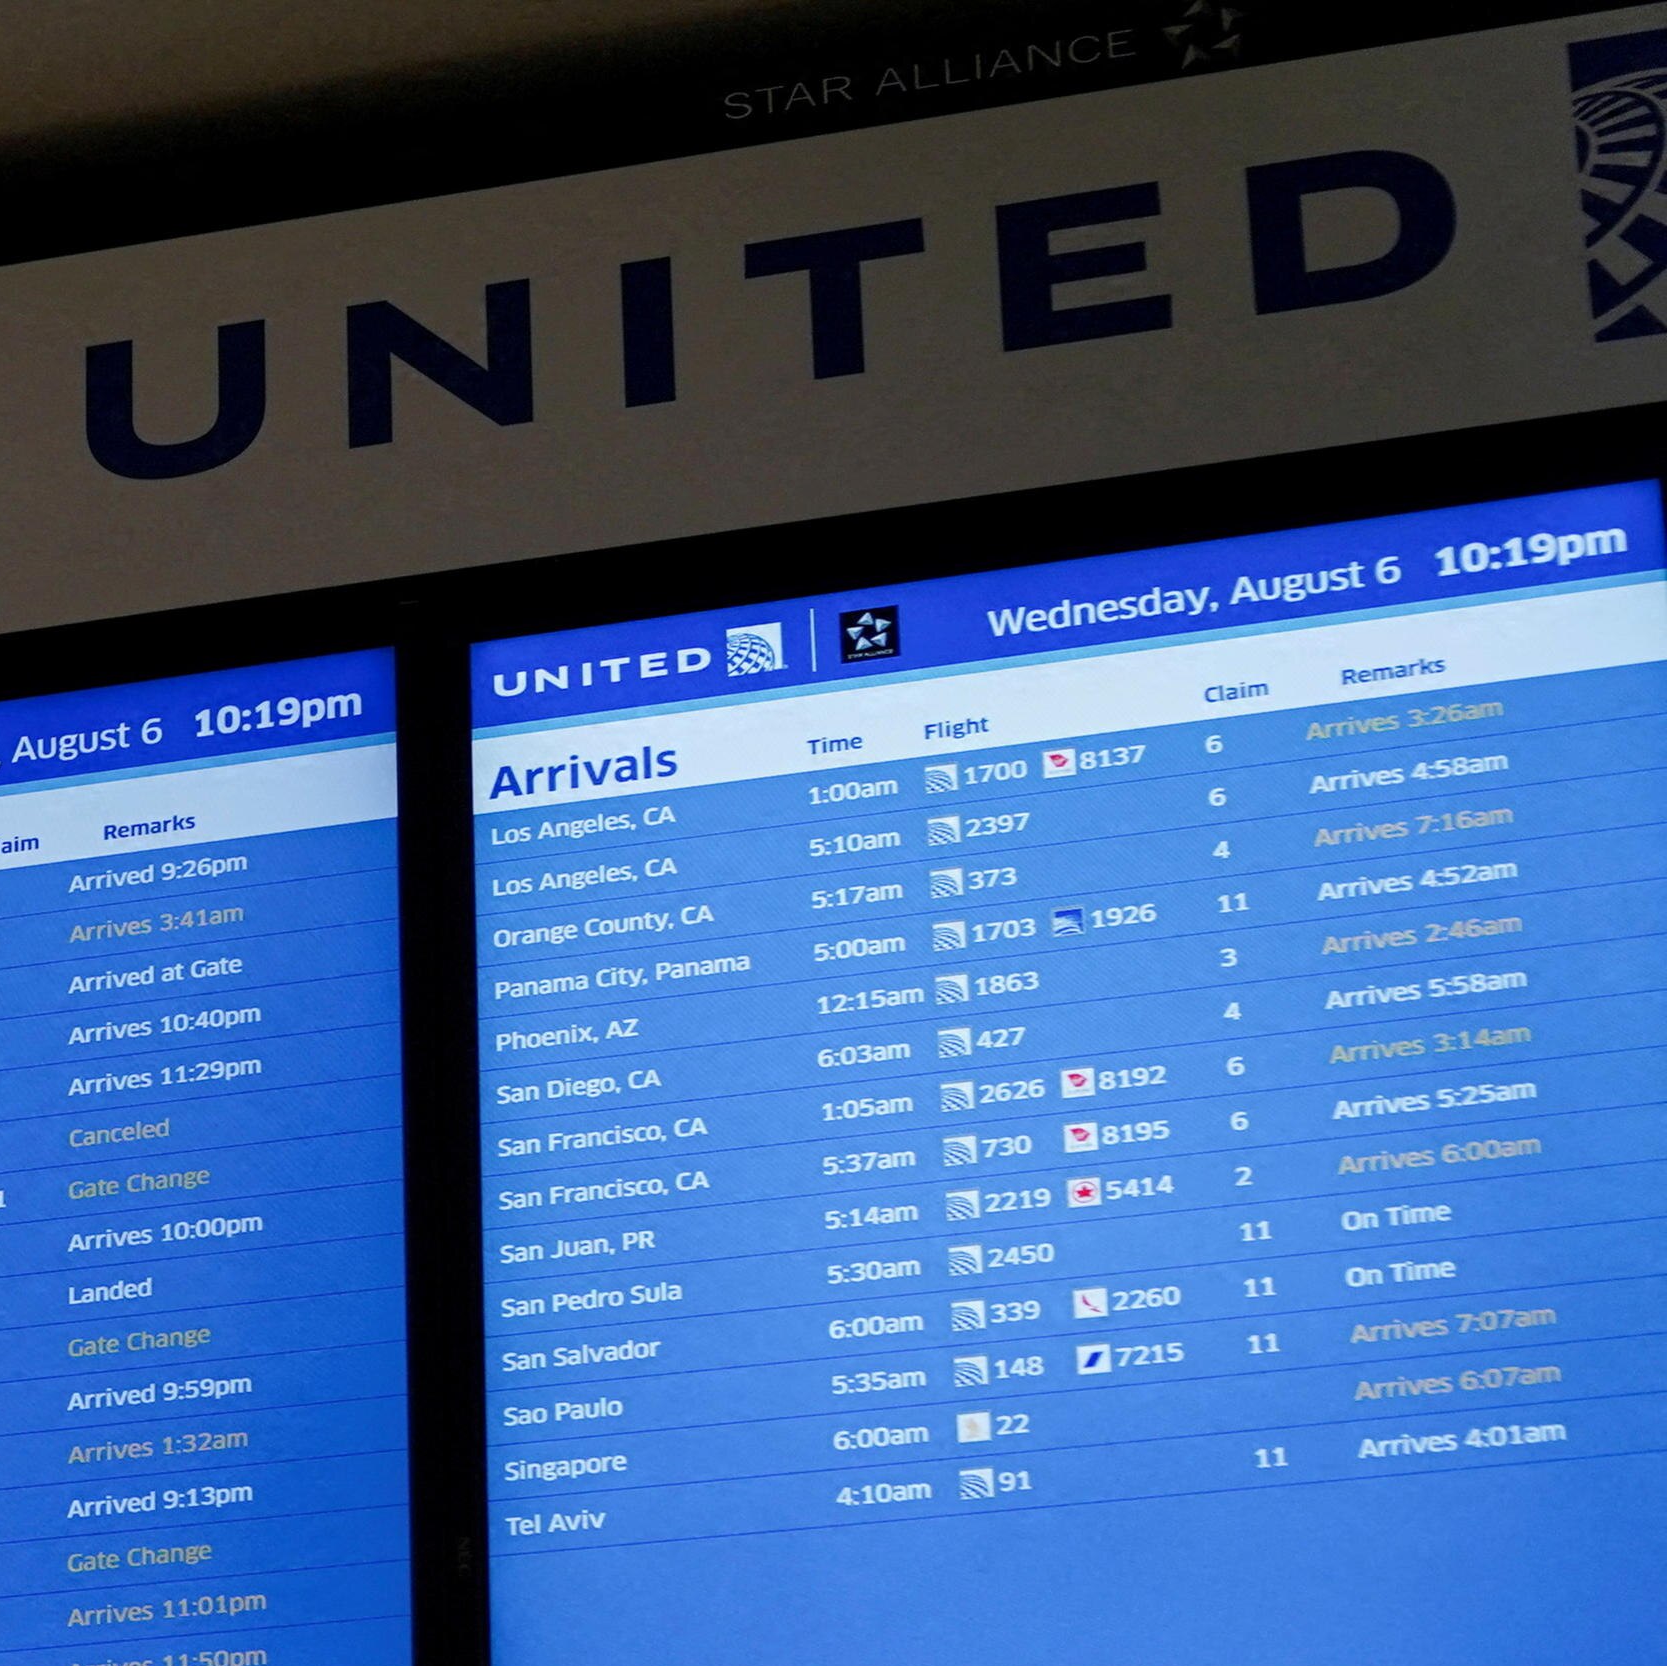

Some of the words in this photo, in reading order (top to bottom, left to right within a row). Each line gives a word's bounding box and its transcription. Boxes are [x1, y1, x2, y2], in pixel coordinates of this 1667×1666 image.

[724, 75, 853, 120] STAR
[876, 29, 1137, 96] ALLIANCE
[85, 150, 1458, 480] UNITED
[986, 586, 1220, 637] Wednesday,
[1229, 560, 1366, 605] August
[1374, 555, 1402, 585] 6
[1434, 527, 1628, 577] 10:19pm
[493, 647, 712, 697] UNITED
[1341, 658, 1447, 686] Remarks
[1203, 681, 1270, 704] Claim
[11, 722, 131, 764] August
[141, 717, 163, 745] 6
[194, 692, 363, 738] 10:19pm
[924, 717, 990, 740] Flight
[1305, 714, 1401, 741] Arrives
[1406, 701, 1505, 728] 3:26am
[806, 736, 863, 755] Time
[1079, 744, 1147, 770] 8137
[1204, 734, 1224, 754] 6
[488, 745, 679, 800] Arrivals
[963, 759, 1029, 785] 1700
[808, 779, 899, 805] 1:00am
[103, 814, 196, 841] Remarks
[490, 826, 533, 846] Los
[536, 812, 637, 840] Angeles,
[642, 805, 677, 827] CA
[68, 863, 155, 894] Arrived
[160, 855, 248, 881] 9:26pm
[1357, 1433, 1459, 1459] Arrives
[1463, 1423, 1568, 1449] 4:01am
[1254, 1446, 1289, 1469] 11
[835, 1482, 933, 1506] 4:10am
[997, 1470, 1033, 1493] 91
[504, 1513, 542, 1537] Tel
[547, 1509, 607, 1533] Aviv
